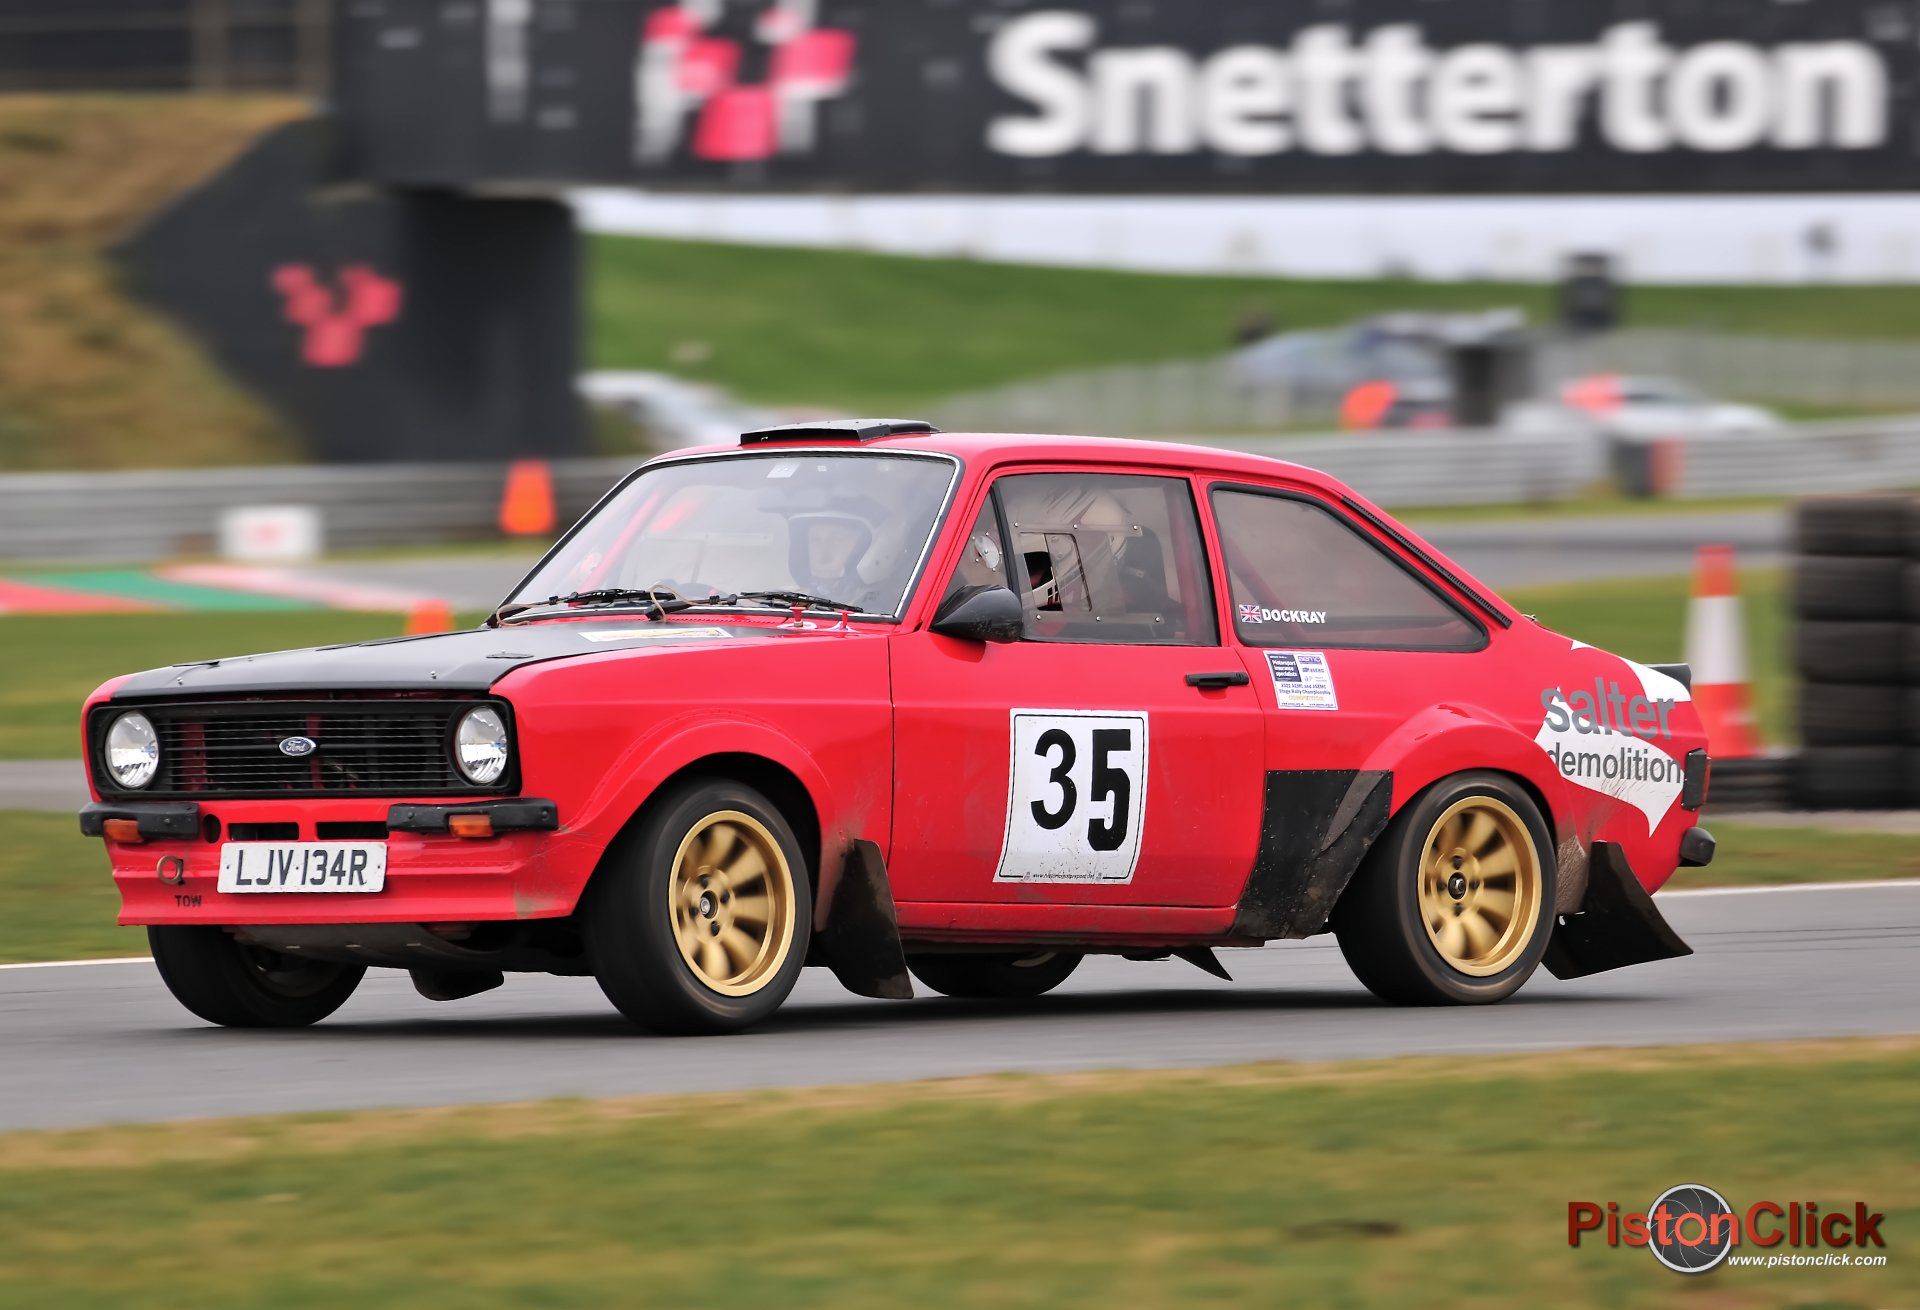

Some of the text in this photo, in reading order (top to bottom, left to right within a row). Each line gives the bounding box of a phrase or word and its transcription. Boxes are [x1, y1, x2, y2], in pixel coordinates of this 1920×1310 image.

[988, 11, 1889, 156] Snetterton
[1261, 609, 1327, 624] DOCKRAY
[1540, 676, 1677, 740] salter
[285, 740, 306, 752] Ford
[1547, 742, 1681, 784] demolition
[1031, 728, 1131, 852] 35
[174, 895, 202, 908] TOW
